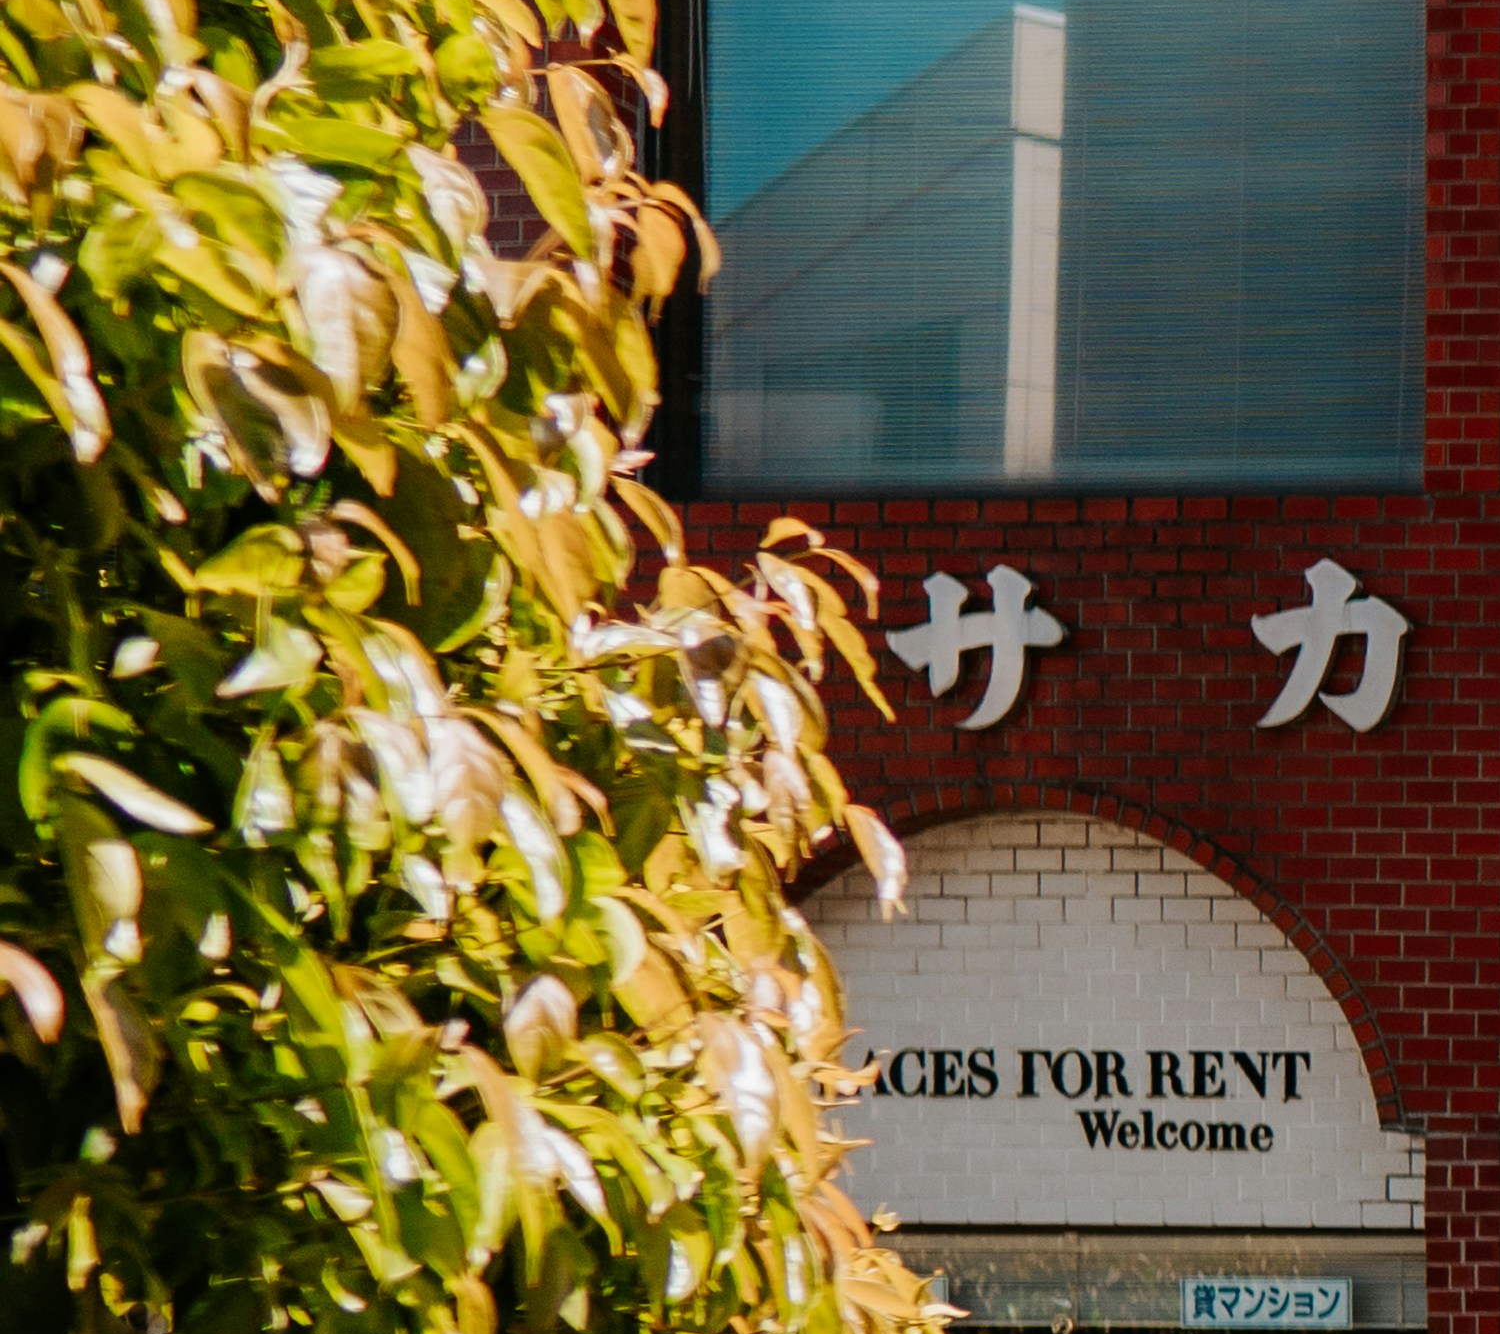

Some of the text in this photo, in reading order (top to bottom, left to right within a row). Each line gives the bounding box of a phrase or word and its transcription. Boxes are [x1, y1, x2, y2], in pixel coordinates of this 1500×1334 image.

[817, 1046, 1000, 1099] ACES
[1147, 1048, 1312, 1101] RENT
[1077, 1109, 1275, 1153] Welcome
[1192, 1283, 1342, 1322] 貸マンション
